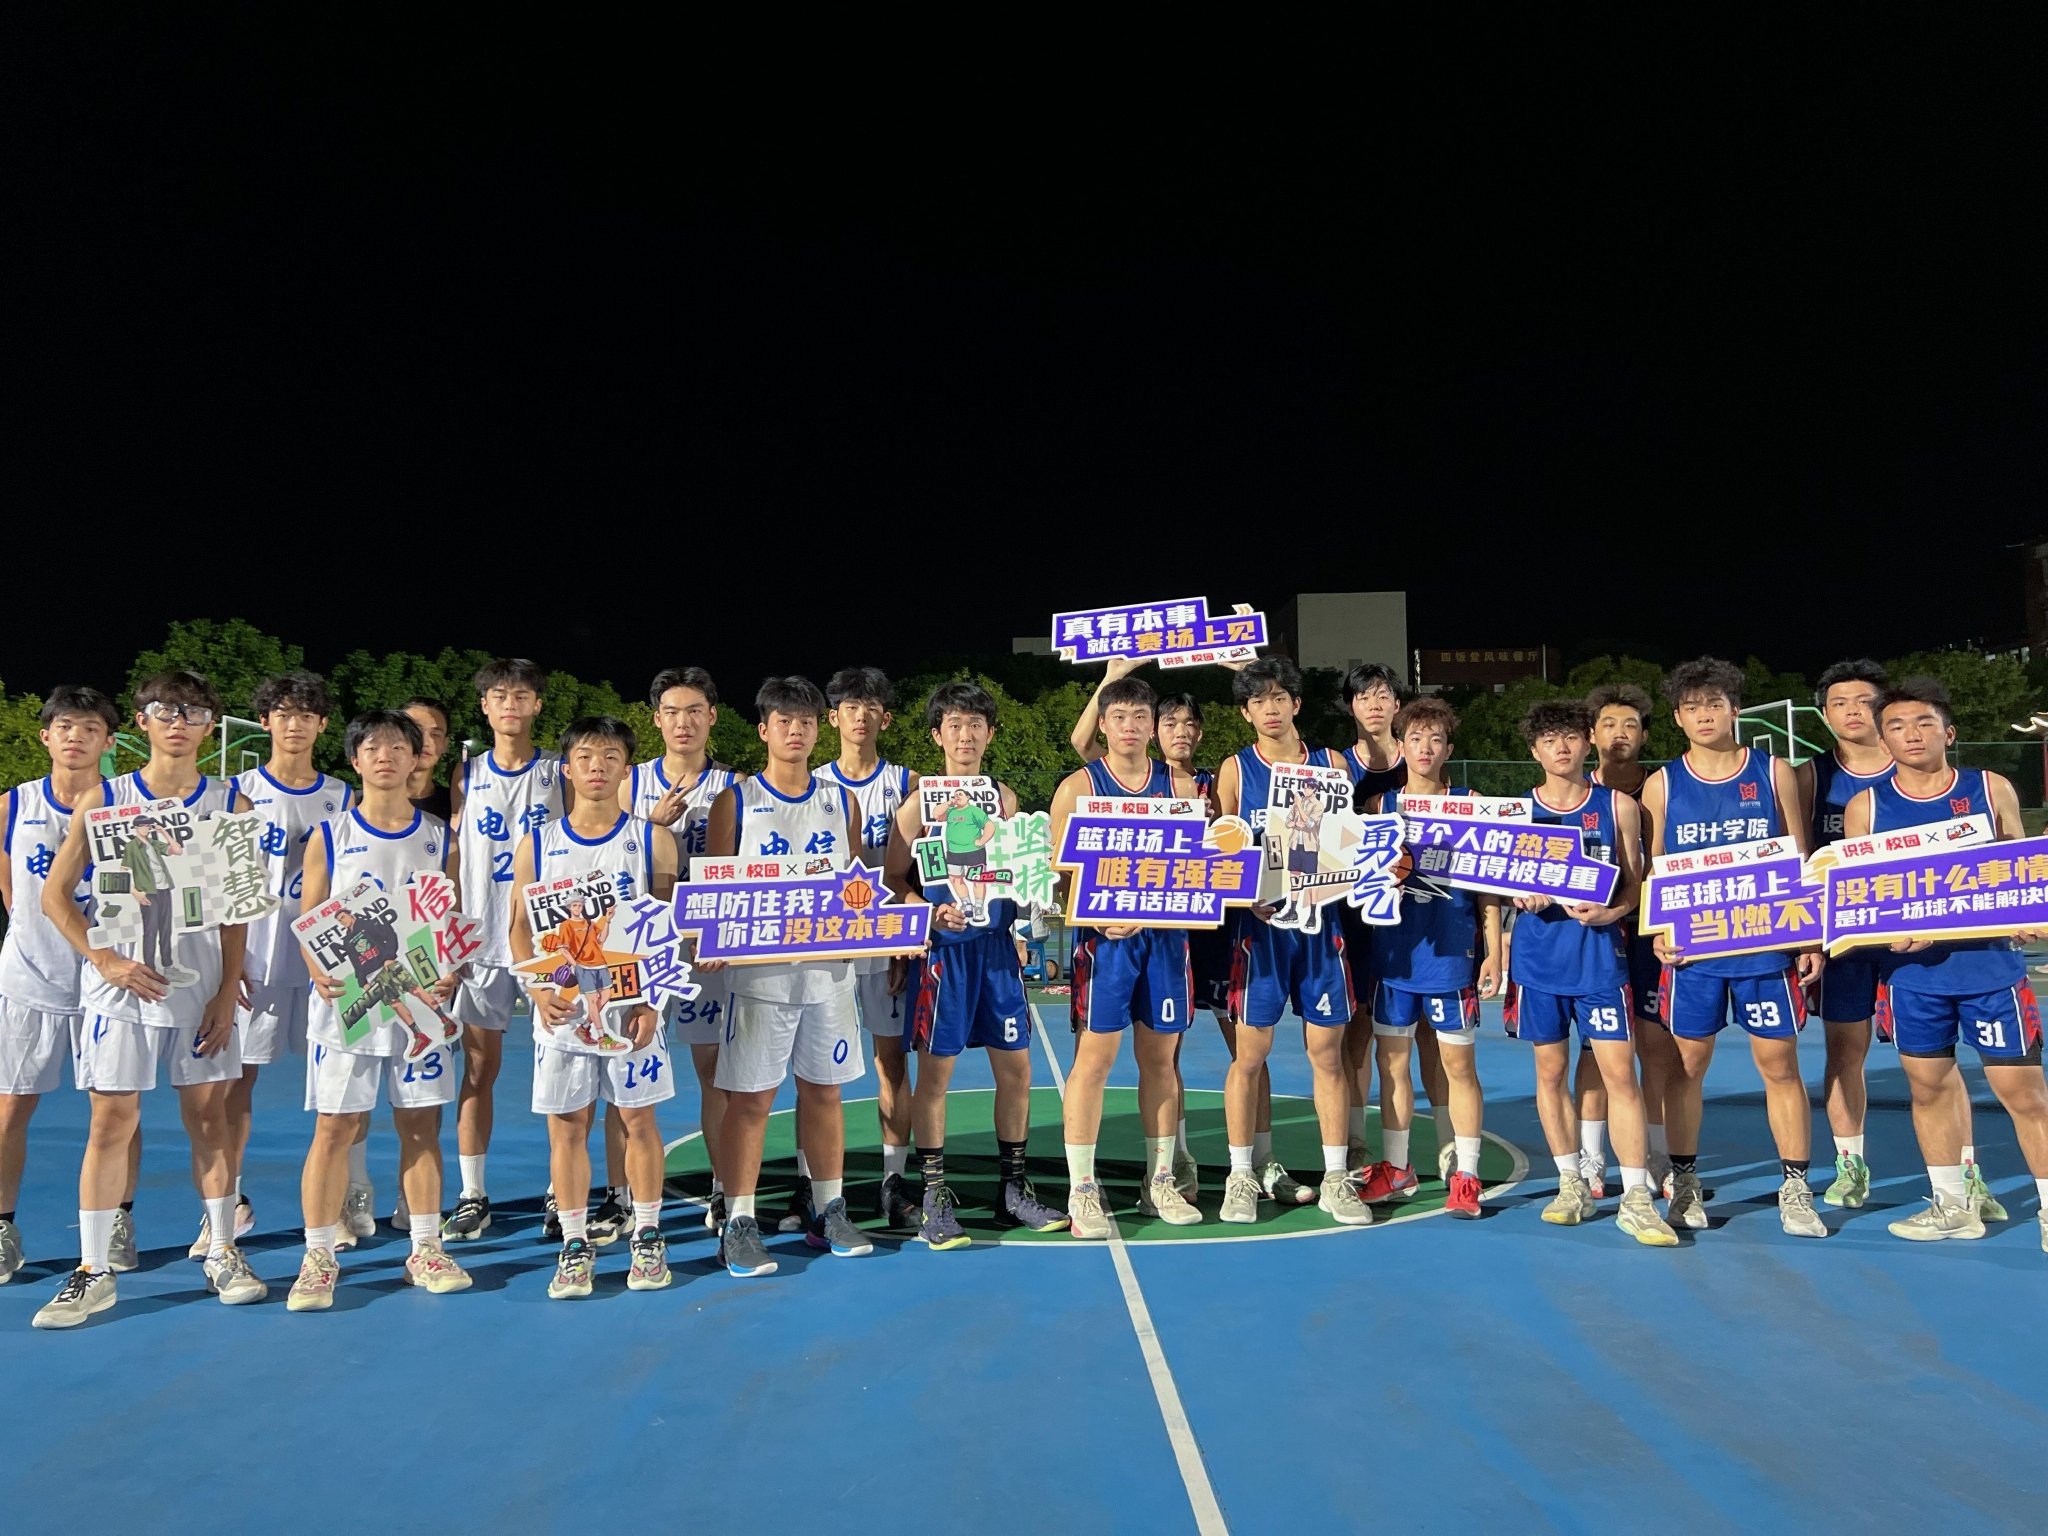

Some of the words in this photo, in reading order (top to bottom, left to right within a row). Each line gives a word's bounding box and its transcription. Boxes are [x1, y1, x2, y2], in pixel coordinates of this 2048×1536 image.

[1062, 604, 1197, 641] 真有本事
[1086, 620, 1256, 655] 就在赛场上见
[1076, 826, 1193, 854] 篮球场上
[1676, 818, 1769, 845] 设计学院
[211, 816, 278, 920] 智慧
[1012, 814, 1053, 902] 坚持
[1095, 856, 1245, 890] 唯有强者
[1353, 819, 1400, 919] 勇气
[1419, 847, 1600, 891] 都值得被尊重
[1660, 871, 1790, 911] 篮球场上
[1835, 854, 2048, 908] 没有什么事情
[1087, 890, 1216, 914] 才有话语权
[1835, 887, 2048, 929] 是打一场球不能解决
[407, 875, 484, 966] 信任
[1689, 897, 1825, 944] 当燃不
[678, 999, 722, 1024] 34
[1161, 998, 1175, 1023] 0
[1316, 993, 1332, 1016] 4
[1431, 998, 1445, 1022] 3
[1589, 1008, 1619, 1032] 45
[1745, 1001, 1781, 1027] 33
[1004, 1017, 1019, 1043] 6
[1975, 1021, 2007, 1048] 31
[403, 1051, 444, 1083] 13
[833, 1038, 848, 1064] 0
[624, 1055, 663, 1089] 14
